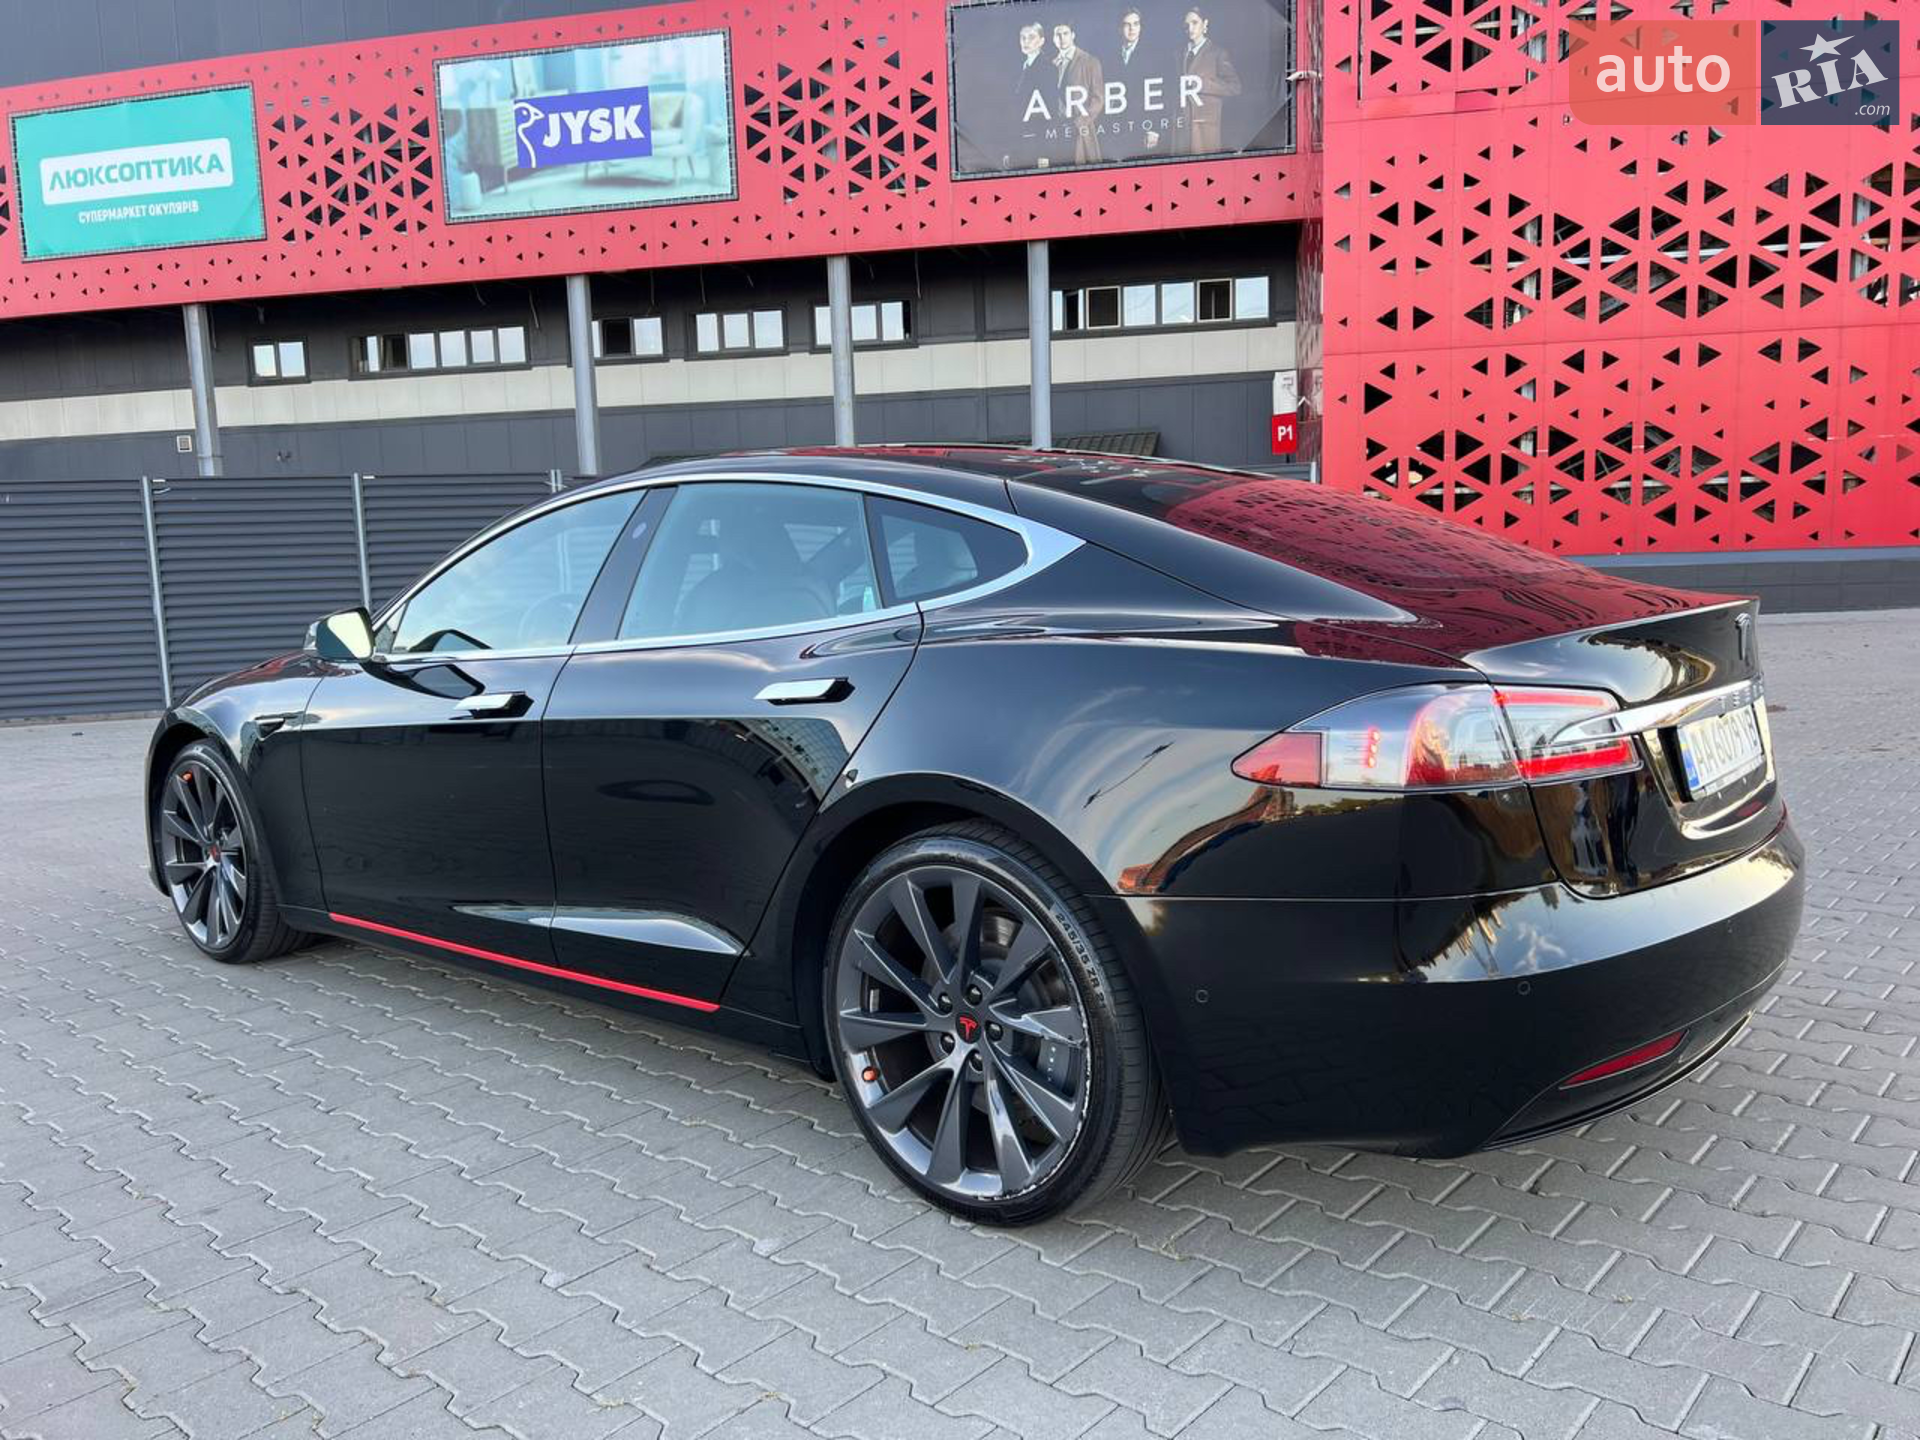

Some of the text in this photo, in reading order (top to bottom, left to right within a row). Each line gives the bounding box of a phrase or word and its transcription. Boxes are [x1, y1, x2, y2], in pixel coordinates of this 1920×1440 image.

[1022, 74, 1204, 122] ARBER
[542, 104, 646, 148] JYSK
[1045, 116, 1185, 140] MEGASTORE
[49, 152, 226, 192] ЛЮКСОПТИКА
[78, 200, 199, 224] СУПЕРМАРКЕТ ОКУЛЯРІВ
[1277, 424, 1293, 442] P1
